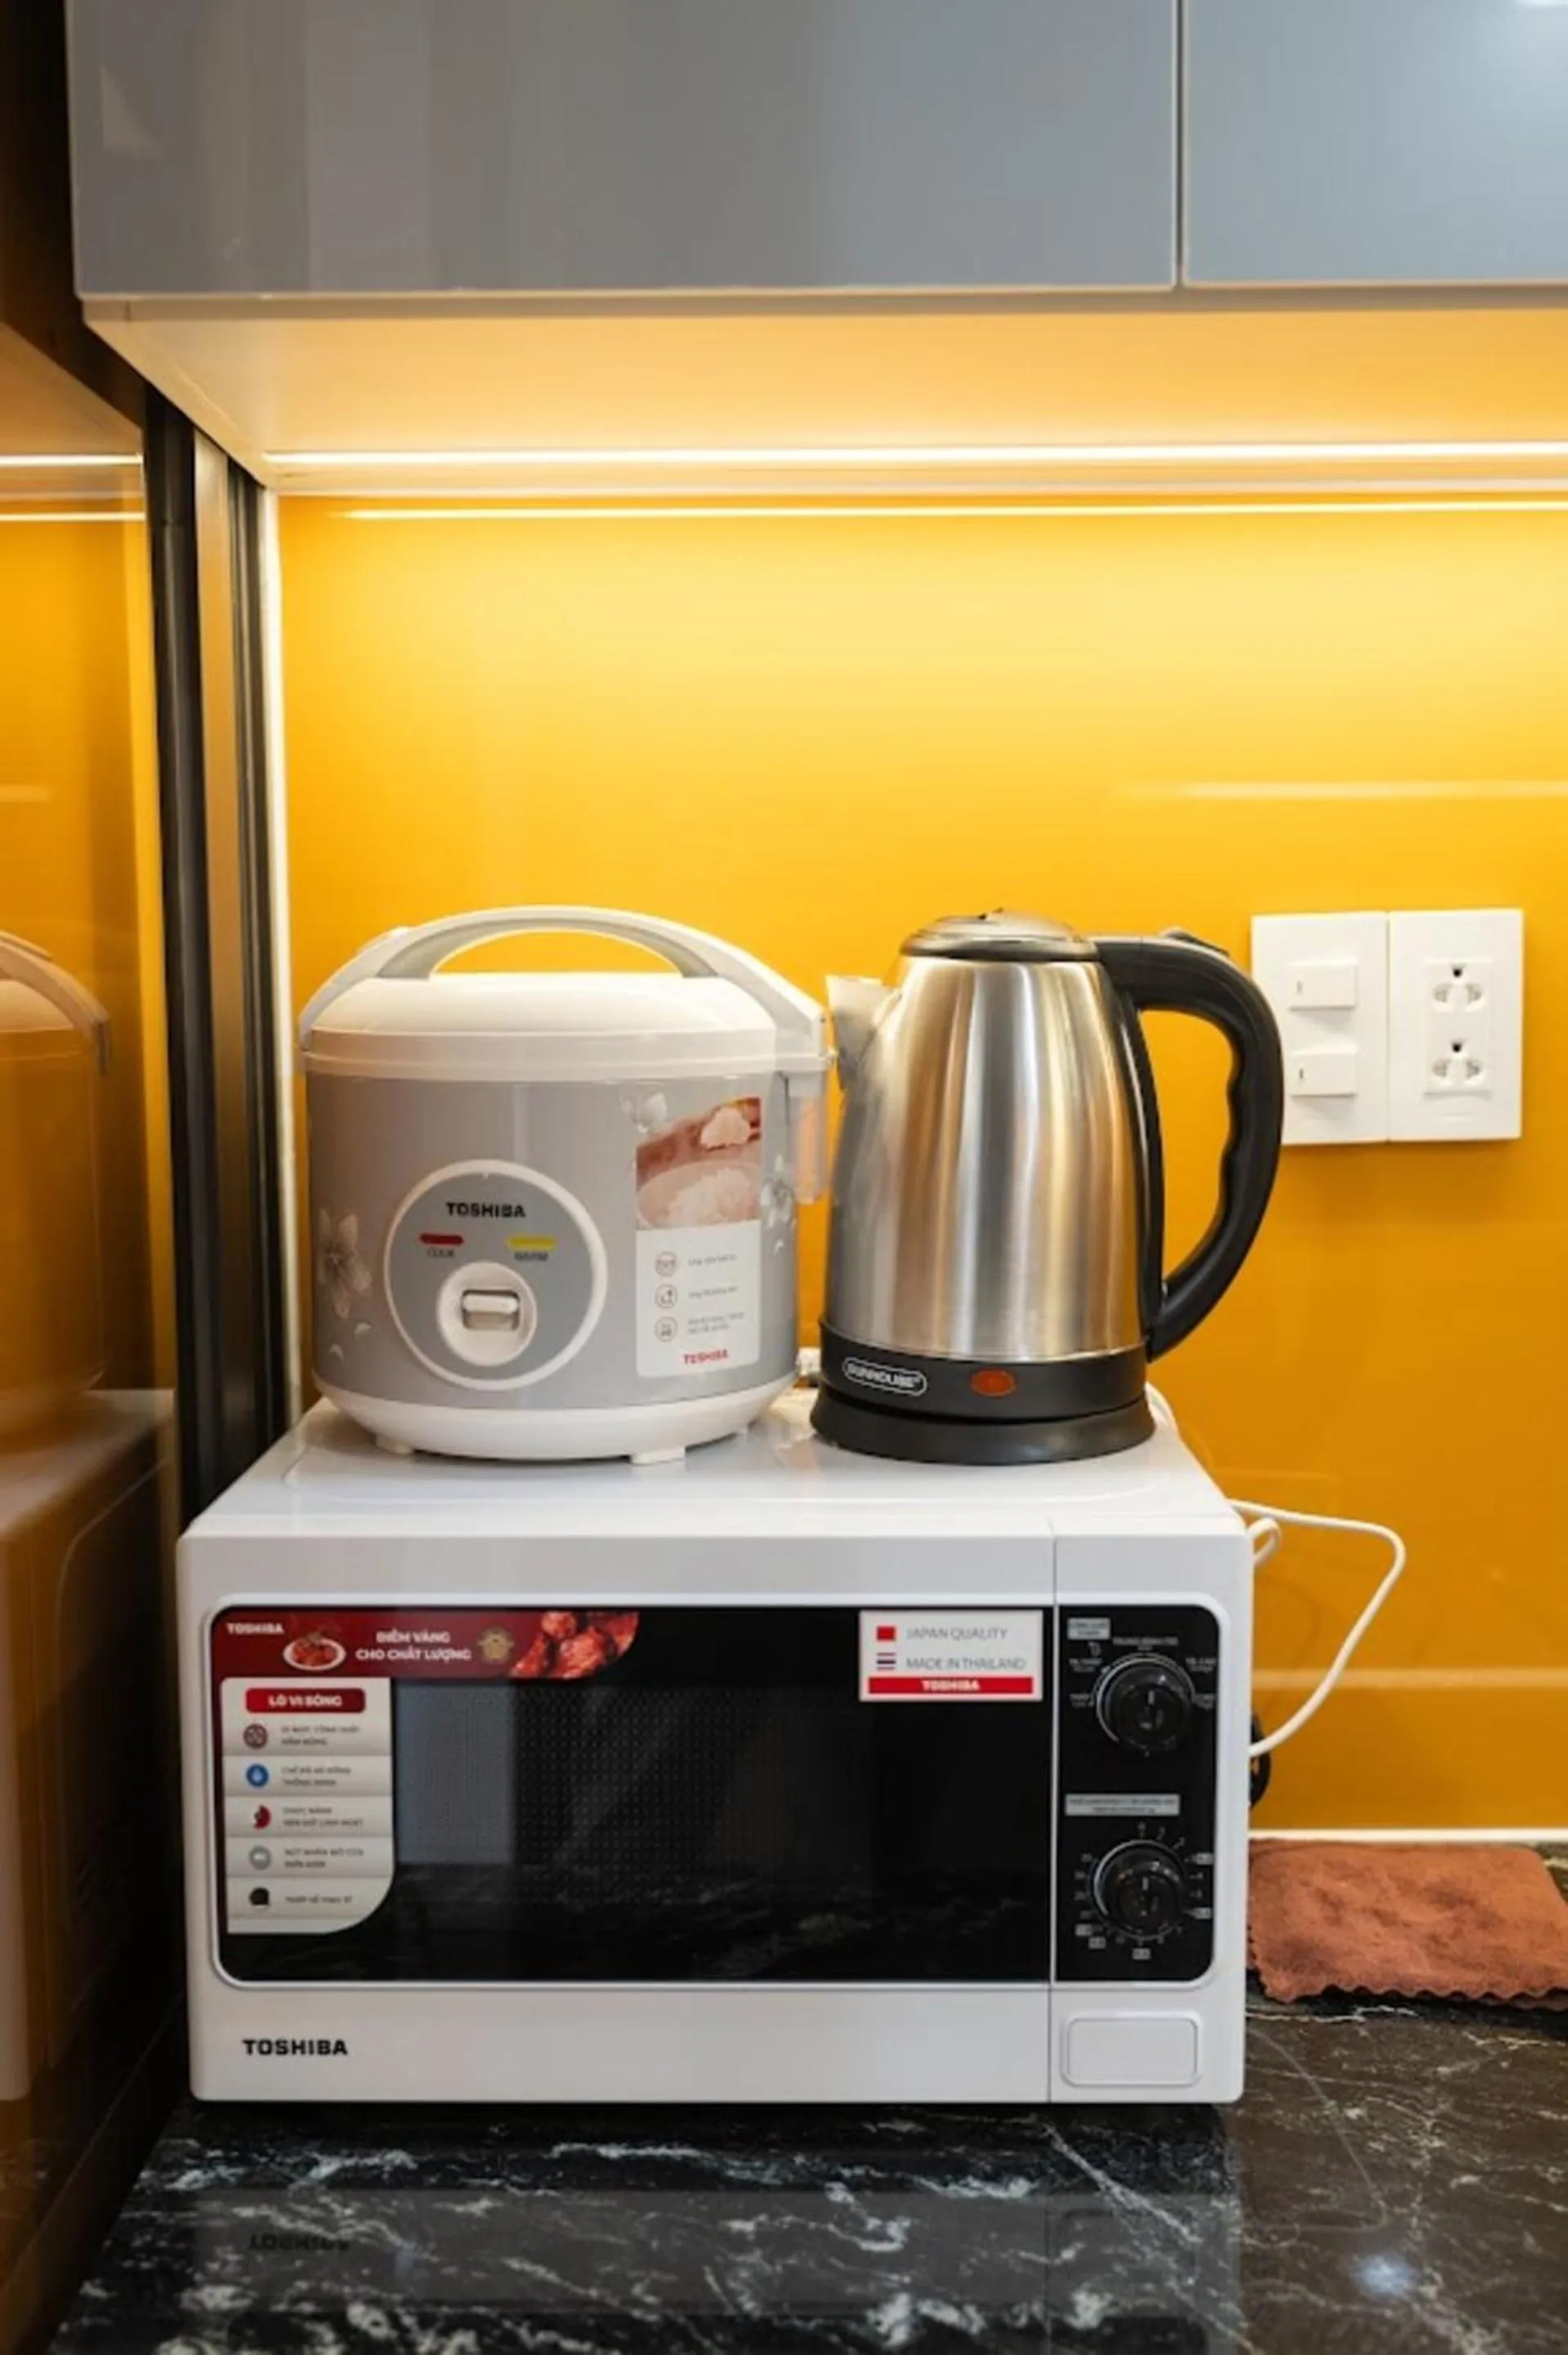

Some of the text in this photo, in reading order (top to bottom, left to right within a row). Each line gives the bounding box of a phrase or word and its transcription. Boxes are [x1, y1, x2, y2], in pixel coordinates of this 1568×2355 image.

[446, 1202, 526, 1218] TOSHIBA
[226, 1622, 285, 1635] TOSHIBA
[906, 1626, 1008, 1641] JAPAN QUALITY
[355, 1647, 386, 1661] CHO
[906, 1657, 1027, 1670] MADE IN THAILAND
[920, 1679, 981, 1692] TOSHIBA
[288, 1695, 303, 1708] VI
[242, 2039, 350, 2056] TOSHIBA
